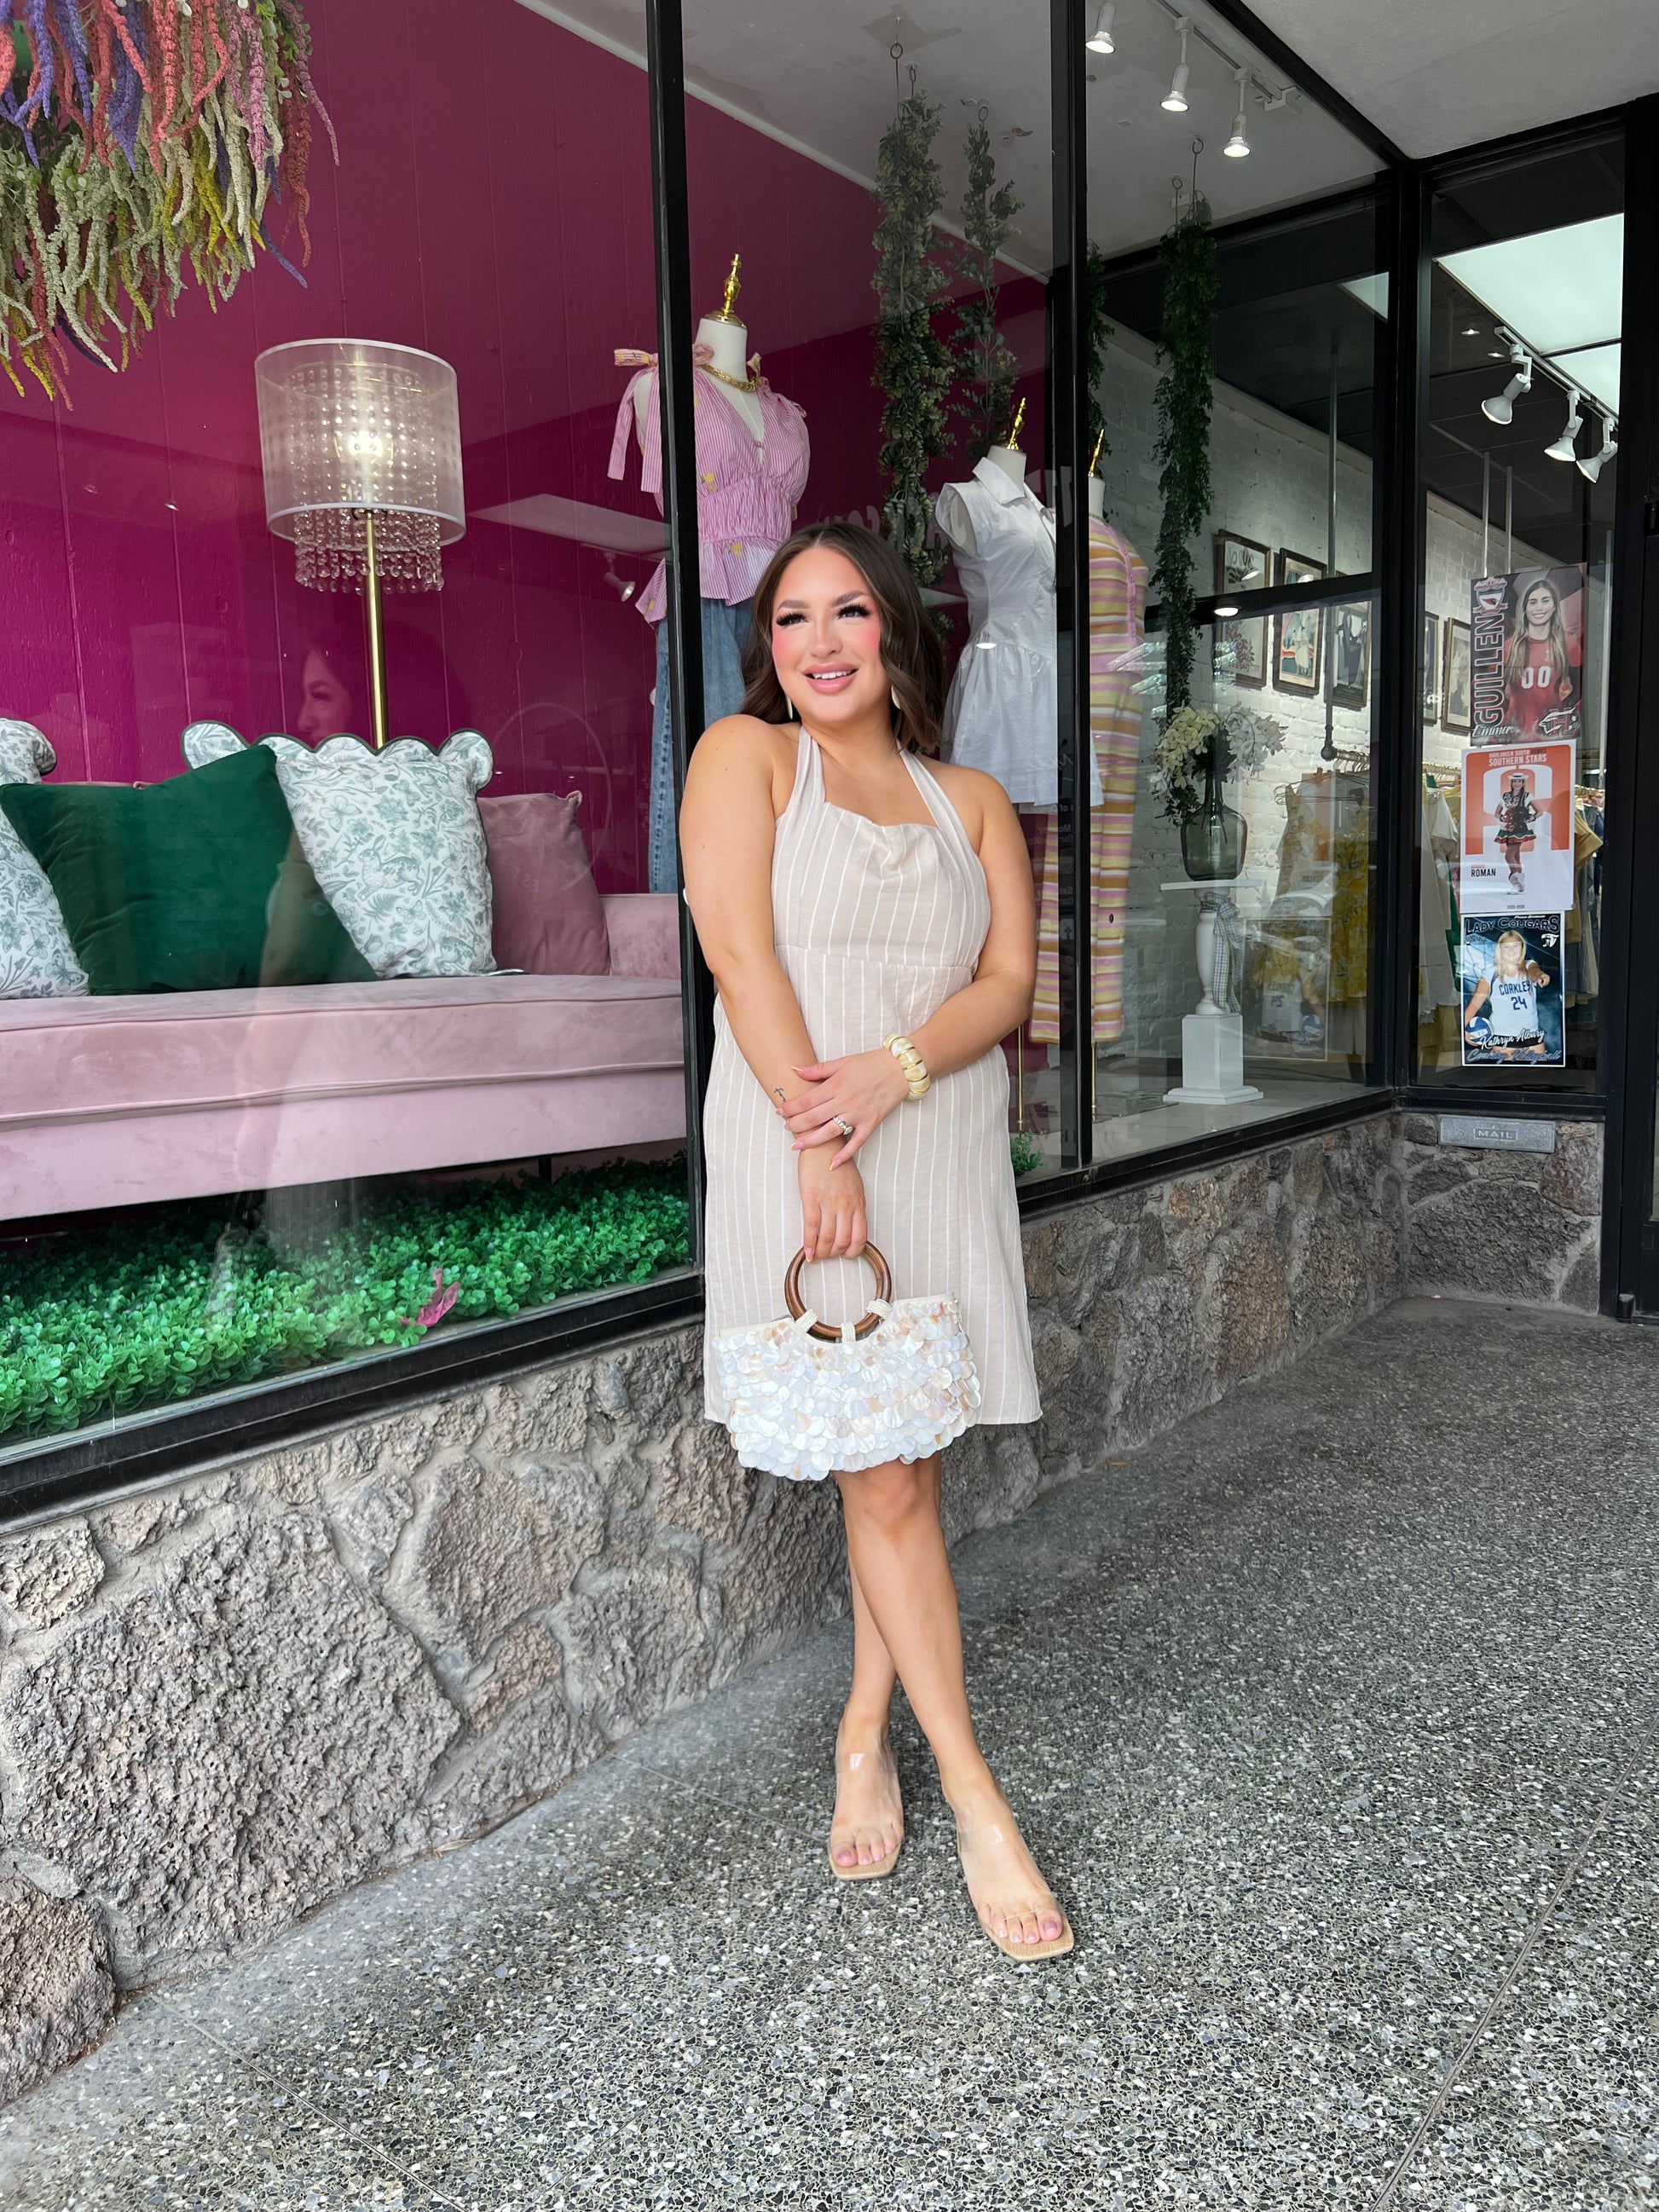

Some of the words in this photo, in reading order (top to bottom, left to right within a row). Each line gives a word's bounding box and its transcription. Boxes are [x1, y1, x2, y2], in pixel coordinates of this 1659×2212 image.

[1474, 614, 1505, 727] GUILLEN
[1521, 666, 1552, 690] 00
[1488, 756, 1524, 767] SOUTHERN
[1524, 754, 1547, 764] STARS
[1471, 869, 1496, 877] ROMAN
[1465, 918, 1496, 933] LADY
[1499, 980, 1531, 996] CORKLEY
[1511, 996, 1528, 1010] 24
[1478, 1034, 1515, 1050] Kathryn
[1477, 1129, 1513, 1139] MAIL
